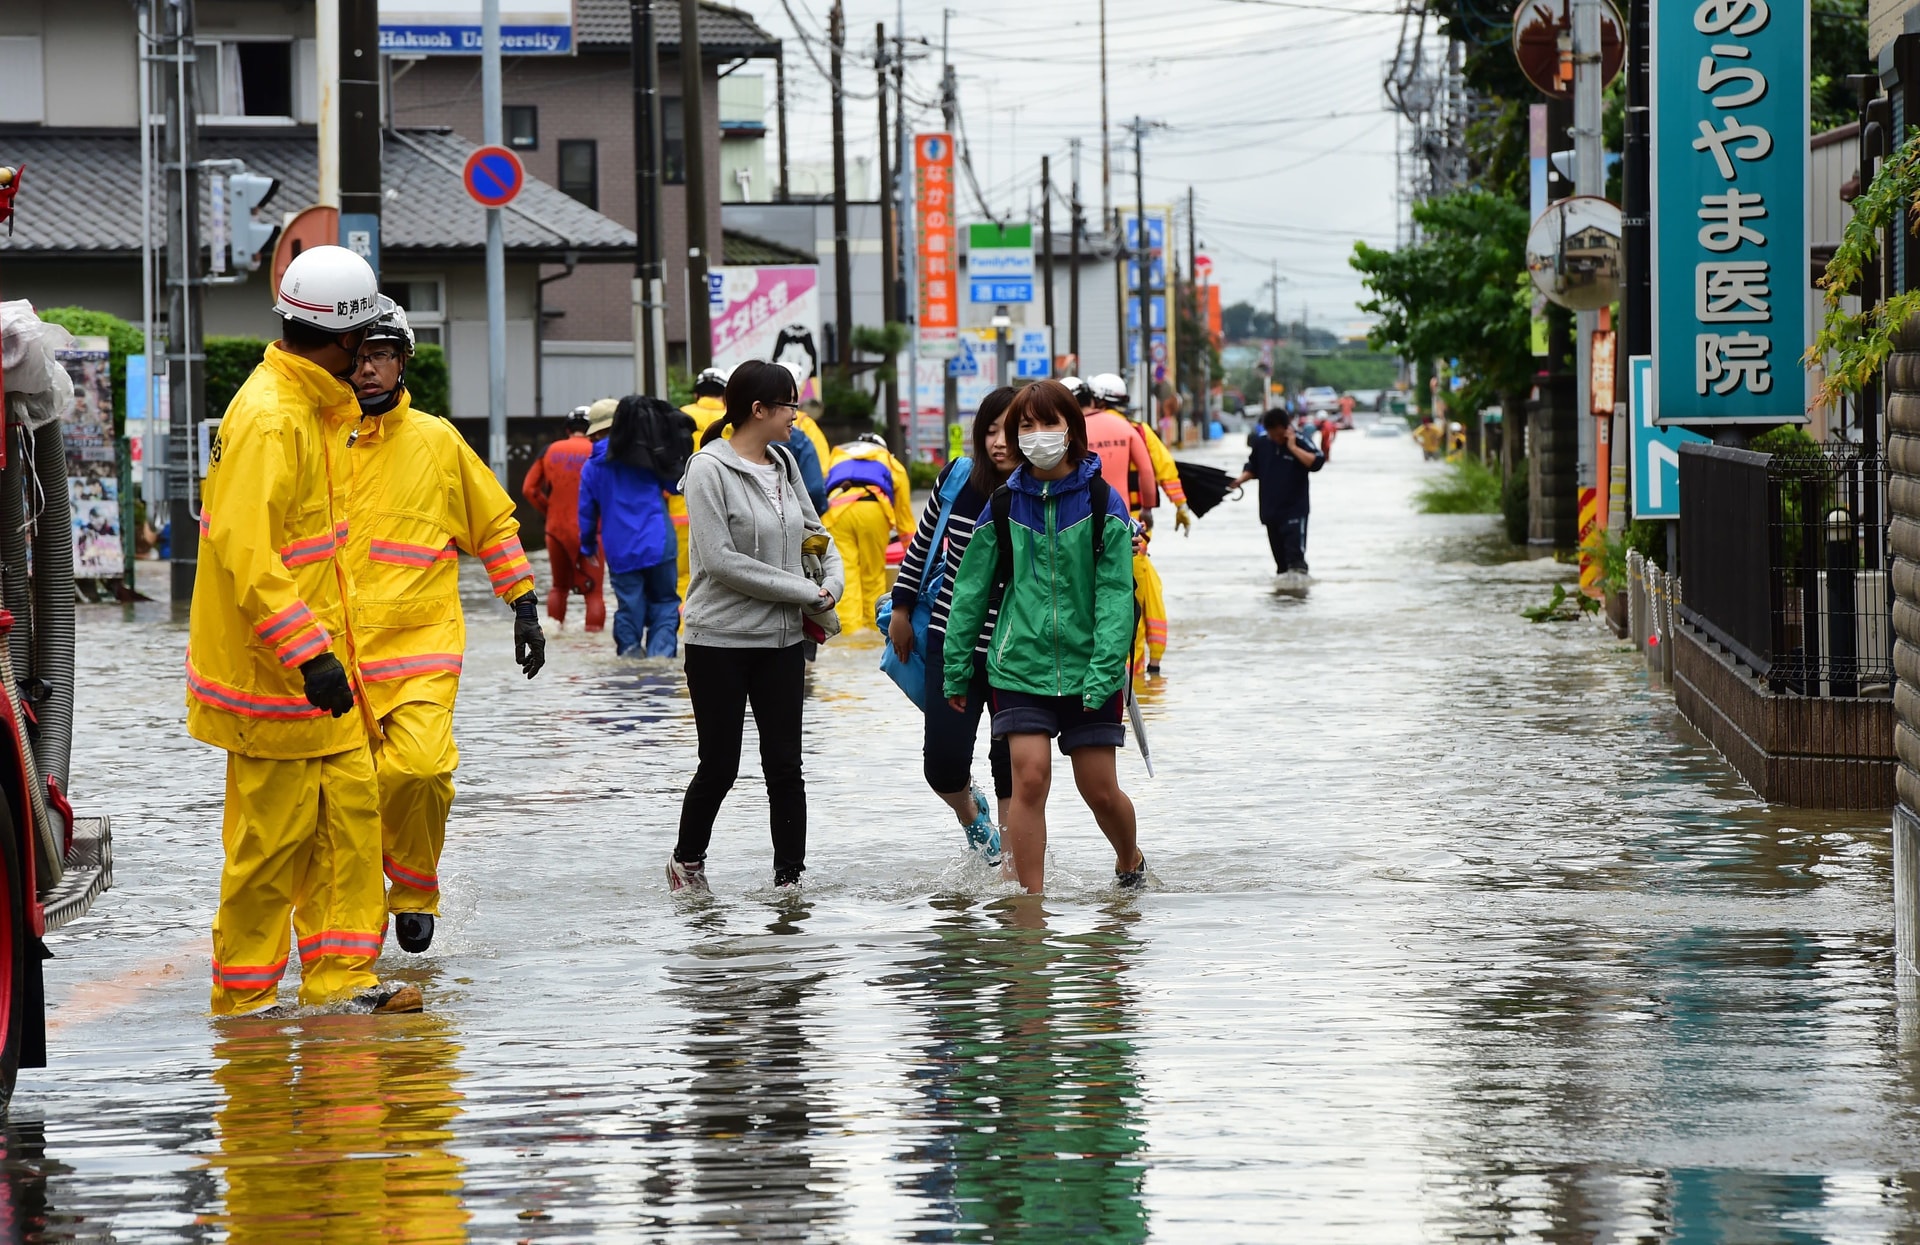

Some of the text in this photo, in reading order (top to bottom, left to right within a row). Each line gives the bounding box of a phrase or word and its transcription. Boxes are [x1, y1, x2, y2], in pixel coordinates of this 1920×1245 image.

[378, 31, 561, 50] Hakuoh Uersity
[1693, 0, 1773, 394] あらやま医院
[927, 164, 948, 323] なかの歯科医院
[971, 256, 1030, 269] FamilyMart
[996, 285, 1029, 300] たばこ
[1021, 344, 1046, 353] ATM
[1025, 358, 1041, 375] P
